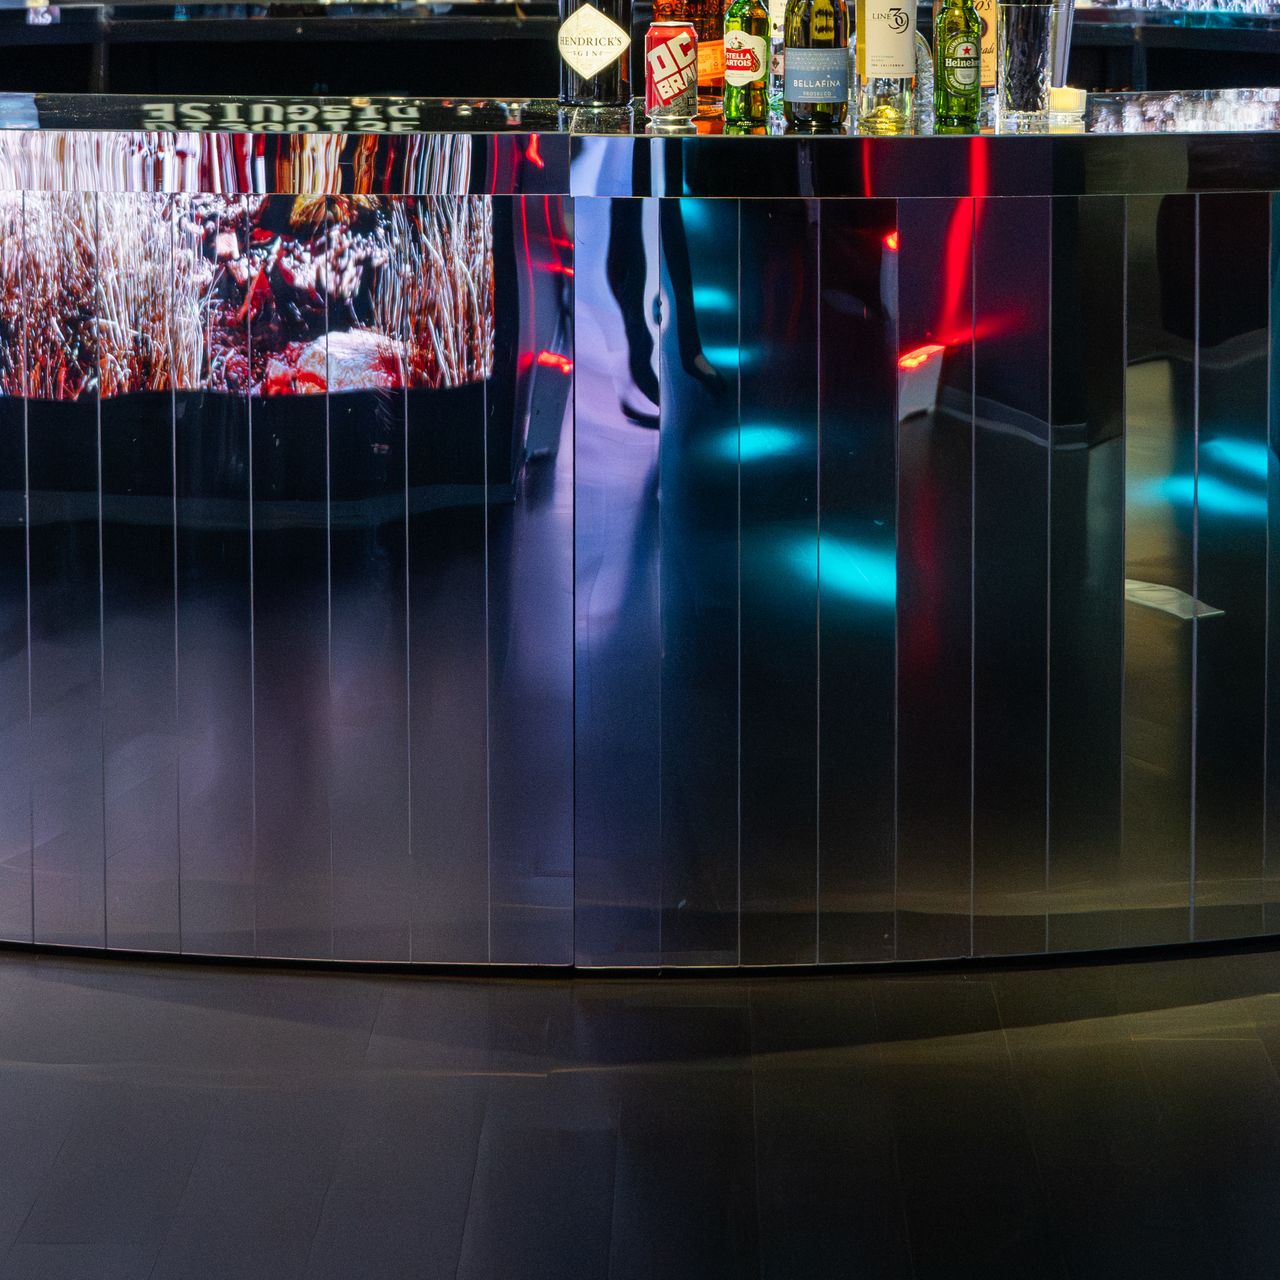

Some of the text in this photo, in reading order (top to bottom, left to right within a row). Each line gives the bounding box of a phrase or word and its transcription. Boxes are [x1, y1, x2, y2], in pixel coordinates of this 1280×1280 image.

[560, 37, 622, 46] HENDRICK'S
[648, 31, 697, 83] DC
[726, 52, 751, 60] STELLA
[726, 59, 752, 67] ARTOIS
[793, 79, 841, 88] BELLAFINA
